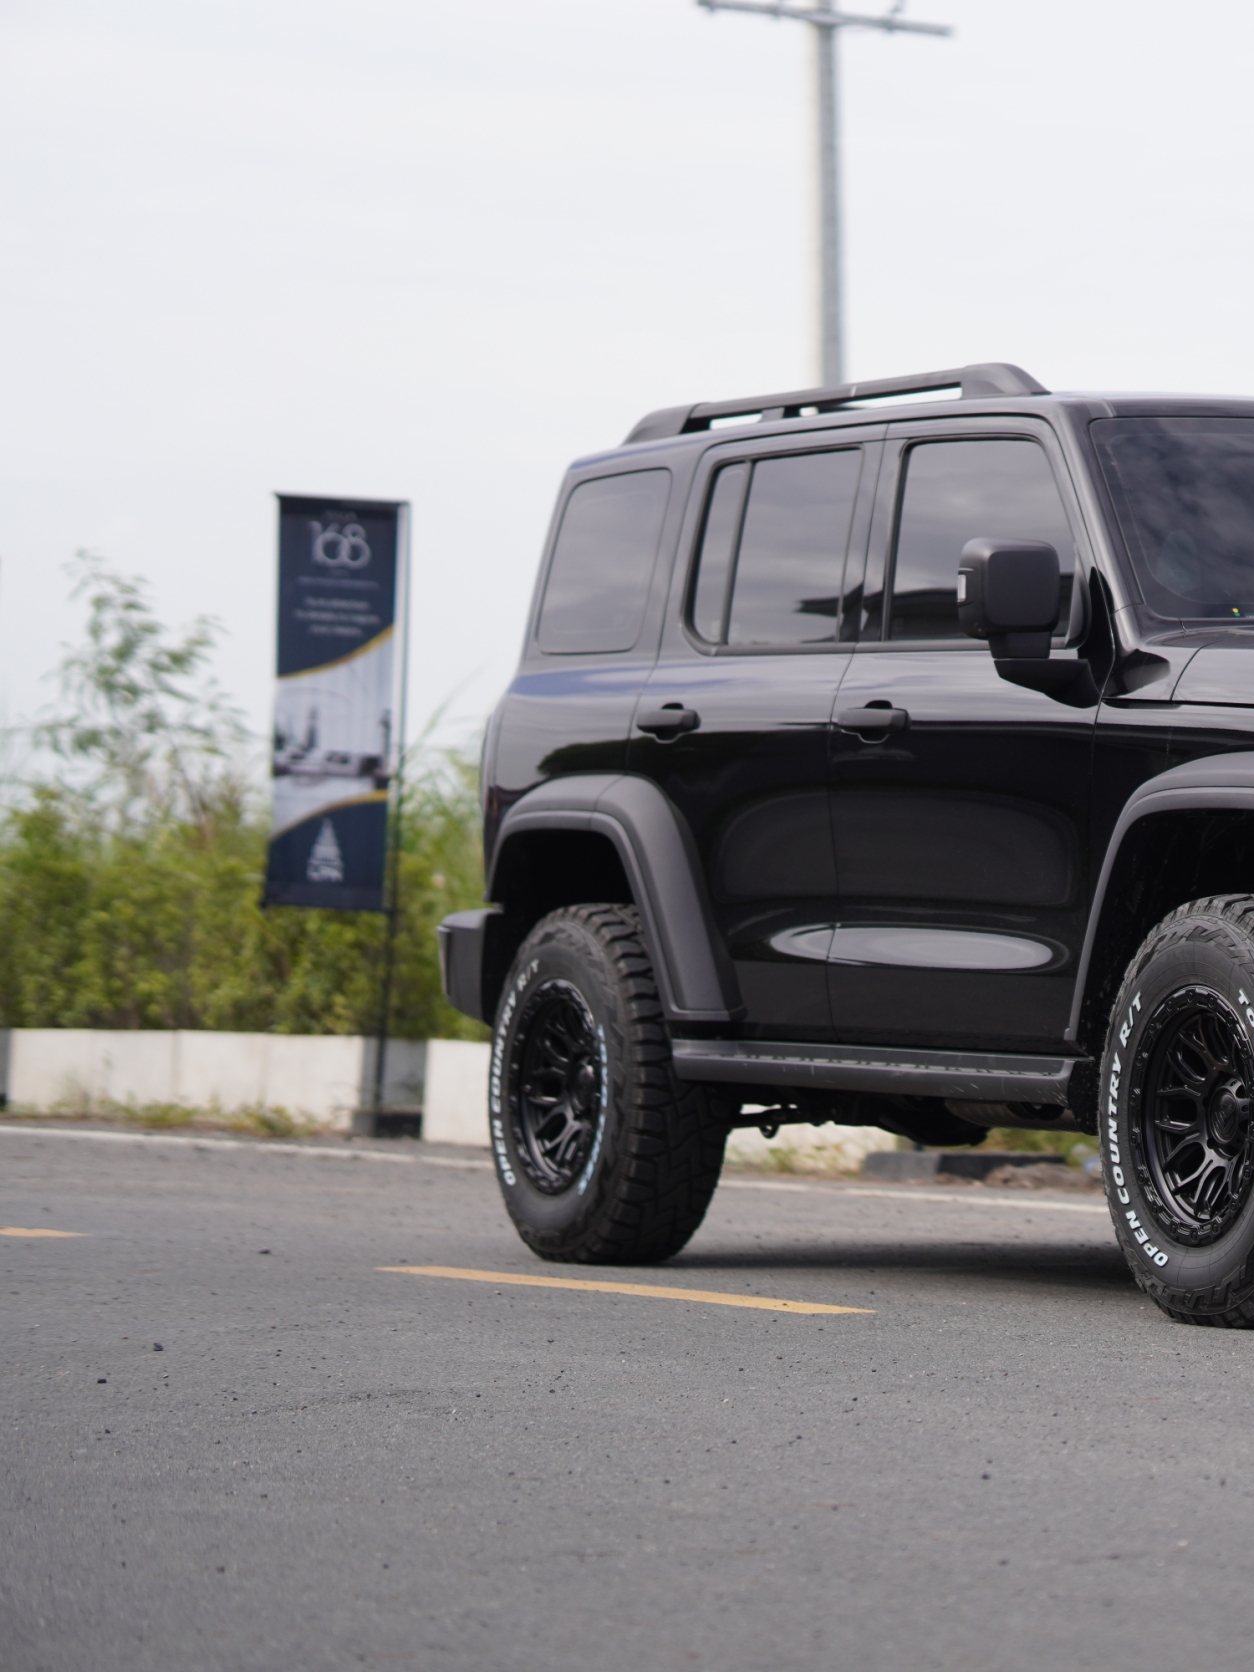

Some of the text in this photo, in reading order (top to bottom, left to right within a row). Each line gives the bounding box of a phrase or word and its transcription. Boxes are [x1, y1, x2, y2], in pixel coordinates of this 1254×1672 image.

[307, 520, 371, 570] 168
[490, 990, 517, 1114] COUNTRY
[492, 1118, 517, 1187] OPEN
[1106, 990, 1170, 1268] OPEN COUNTRY R/T
